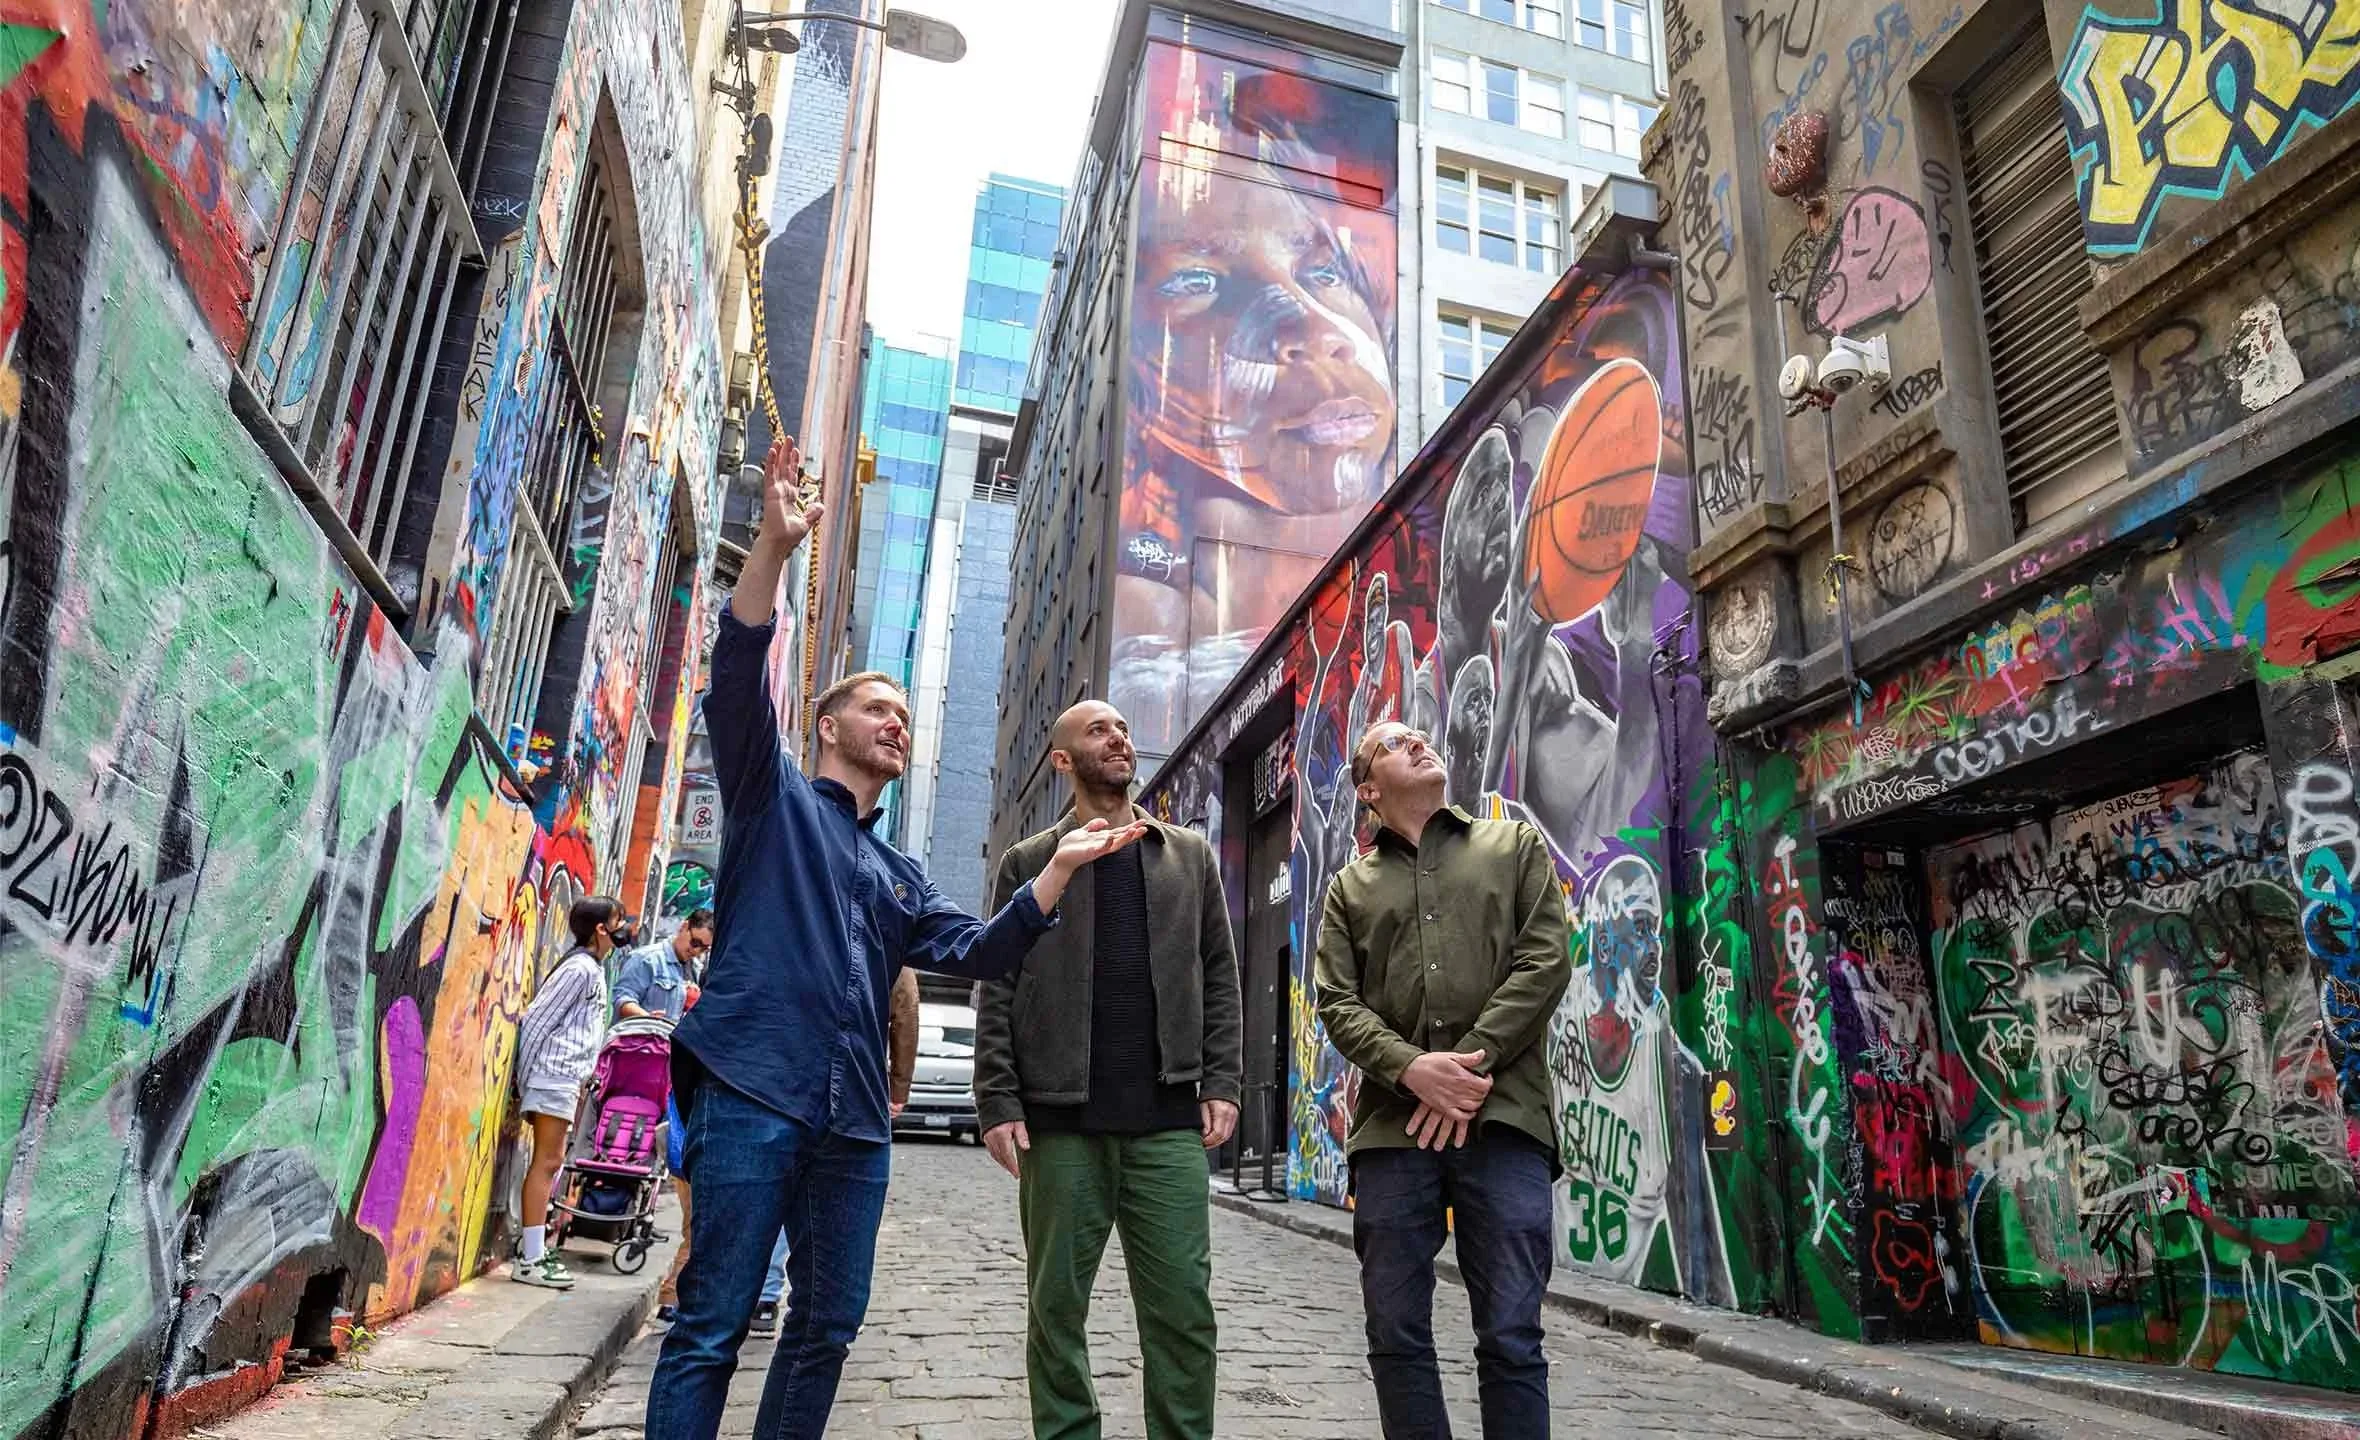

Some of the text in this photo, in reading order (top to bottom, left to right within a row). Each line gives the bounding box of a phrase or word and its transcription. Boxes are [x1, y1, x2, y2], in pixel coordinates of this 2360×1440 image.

[695, 795, 714, 806] END
[686, 829, 712, 841] AREA
[1563, 1098, 1642, 1198] CELTICS
[1569, 1179, 1631, 1265] 36
